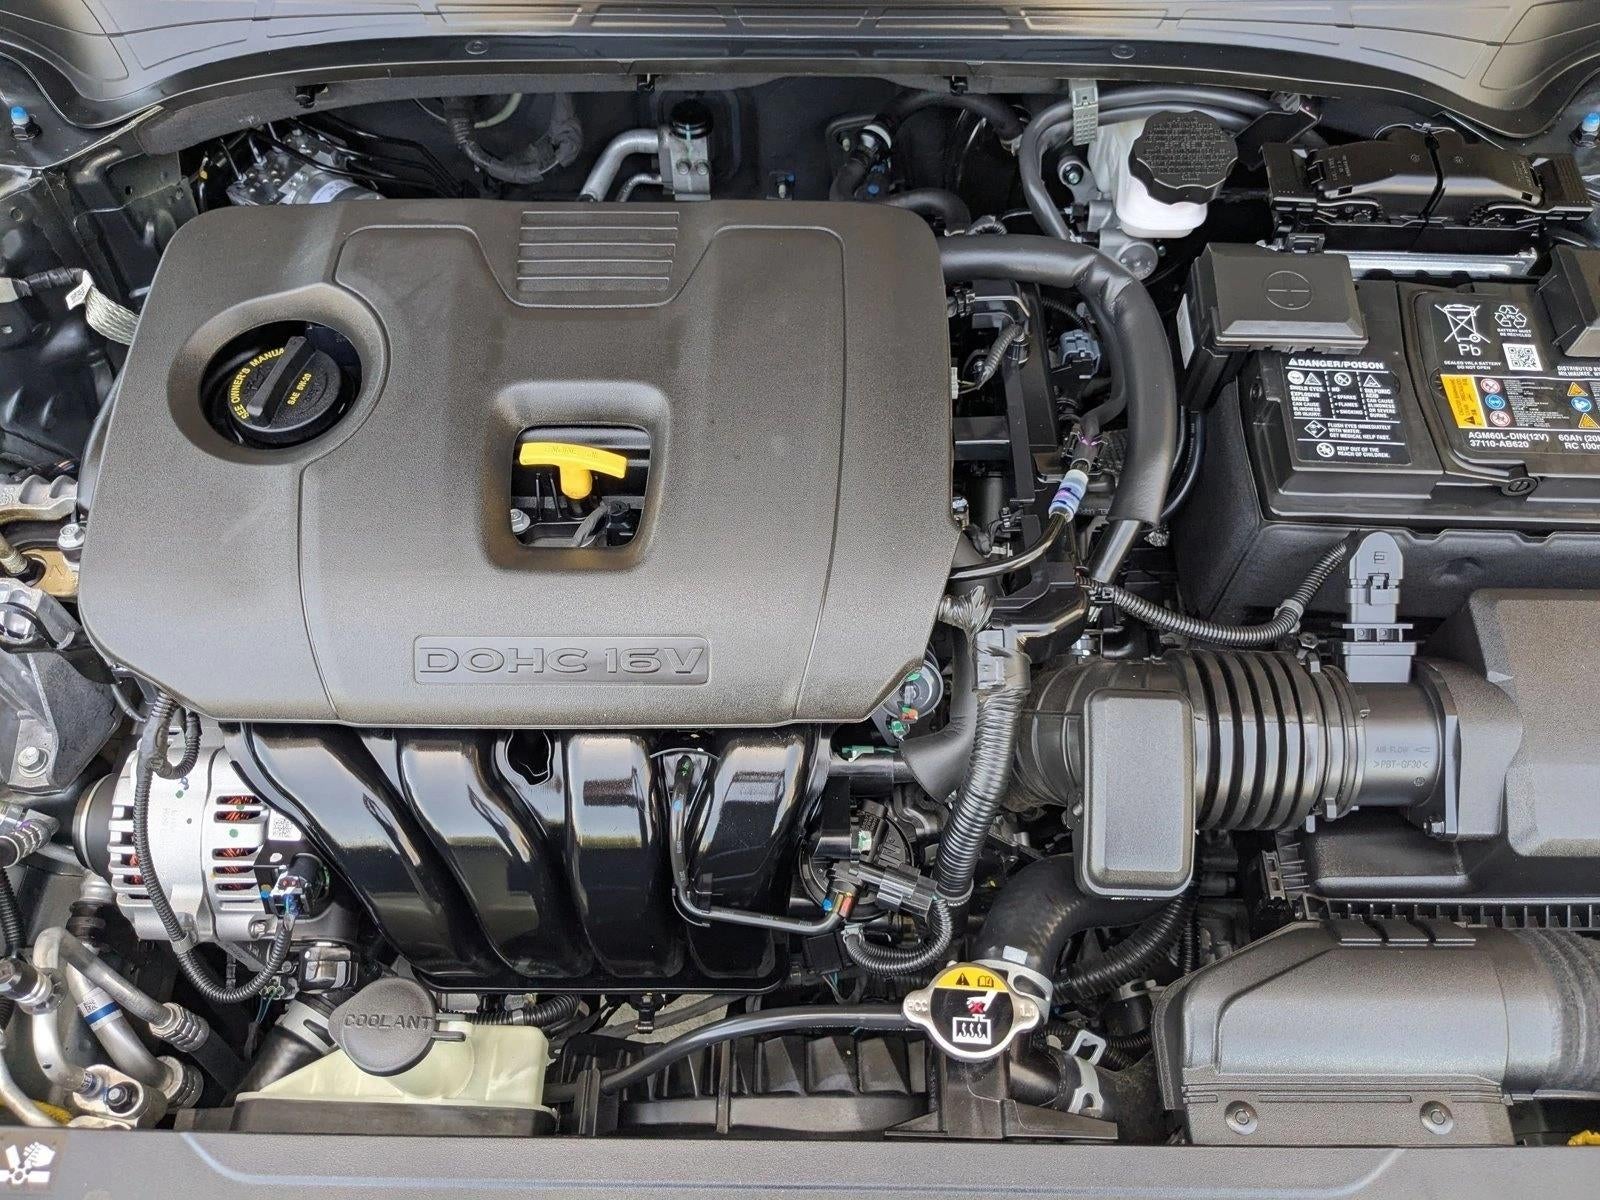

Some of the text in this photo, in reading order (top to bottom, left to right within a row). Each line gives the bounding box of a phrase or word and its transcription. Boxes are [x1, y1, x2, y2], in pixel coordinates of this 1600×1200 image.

[250, 347, 285, 367] MANUA
[1458, 344, 1481, 356] Pb
[1297, 359, 1384, 370] DANGER/POISON
[230, 368, 251, 403] OWNER'S
[287, 390, 300, 405] SAE
[234, 403, 250, 420] SEE
[1468, 432, 1549, 442] AGM60L-DIN(12V)
[1558, 434, 1582, 442] 60Ah
[420, 648, 702, 674] DOHC 16V
[344, 1014, 432, 1030] COOLANT
